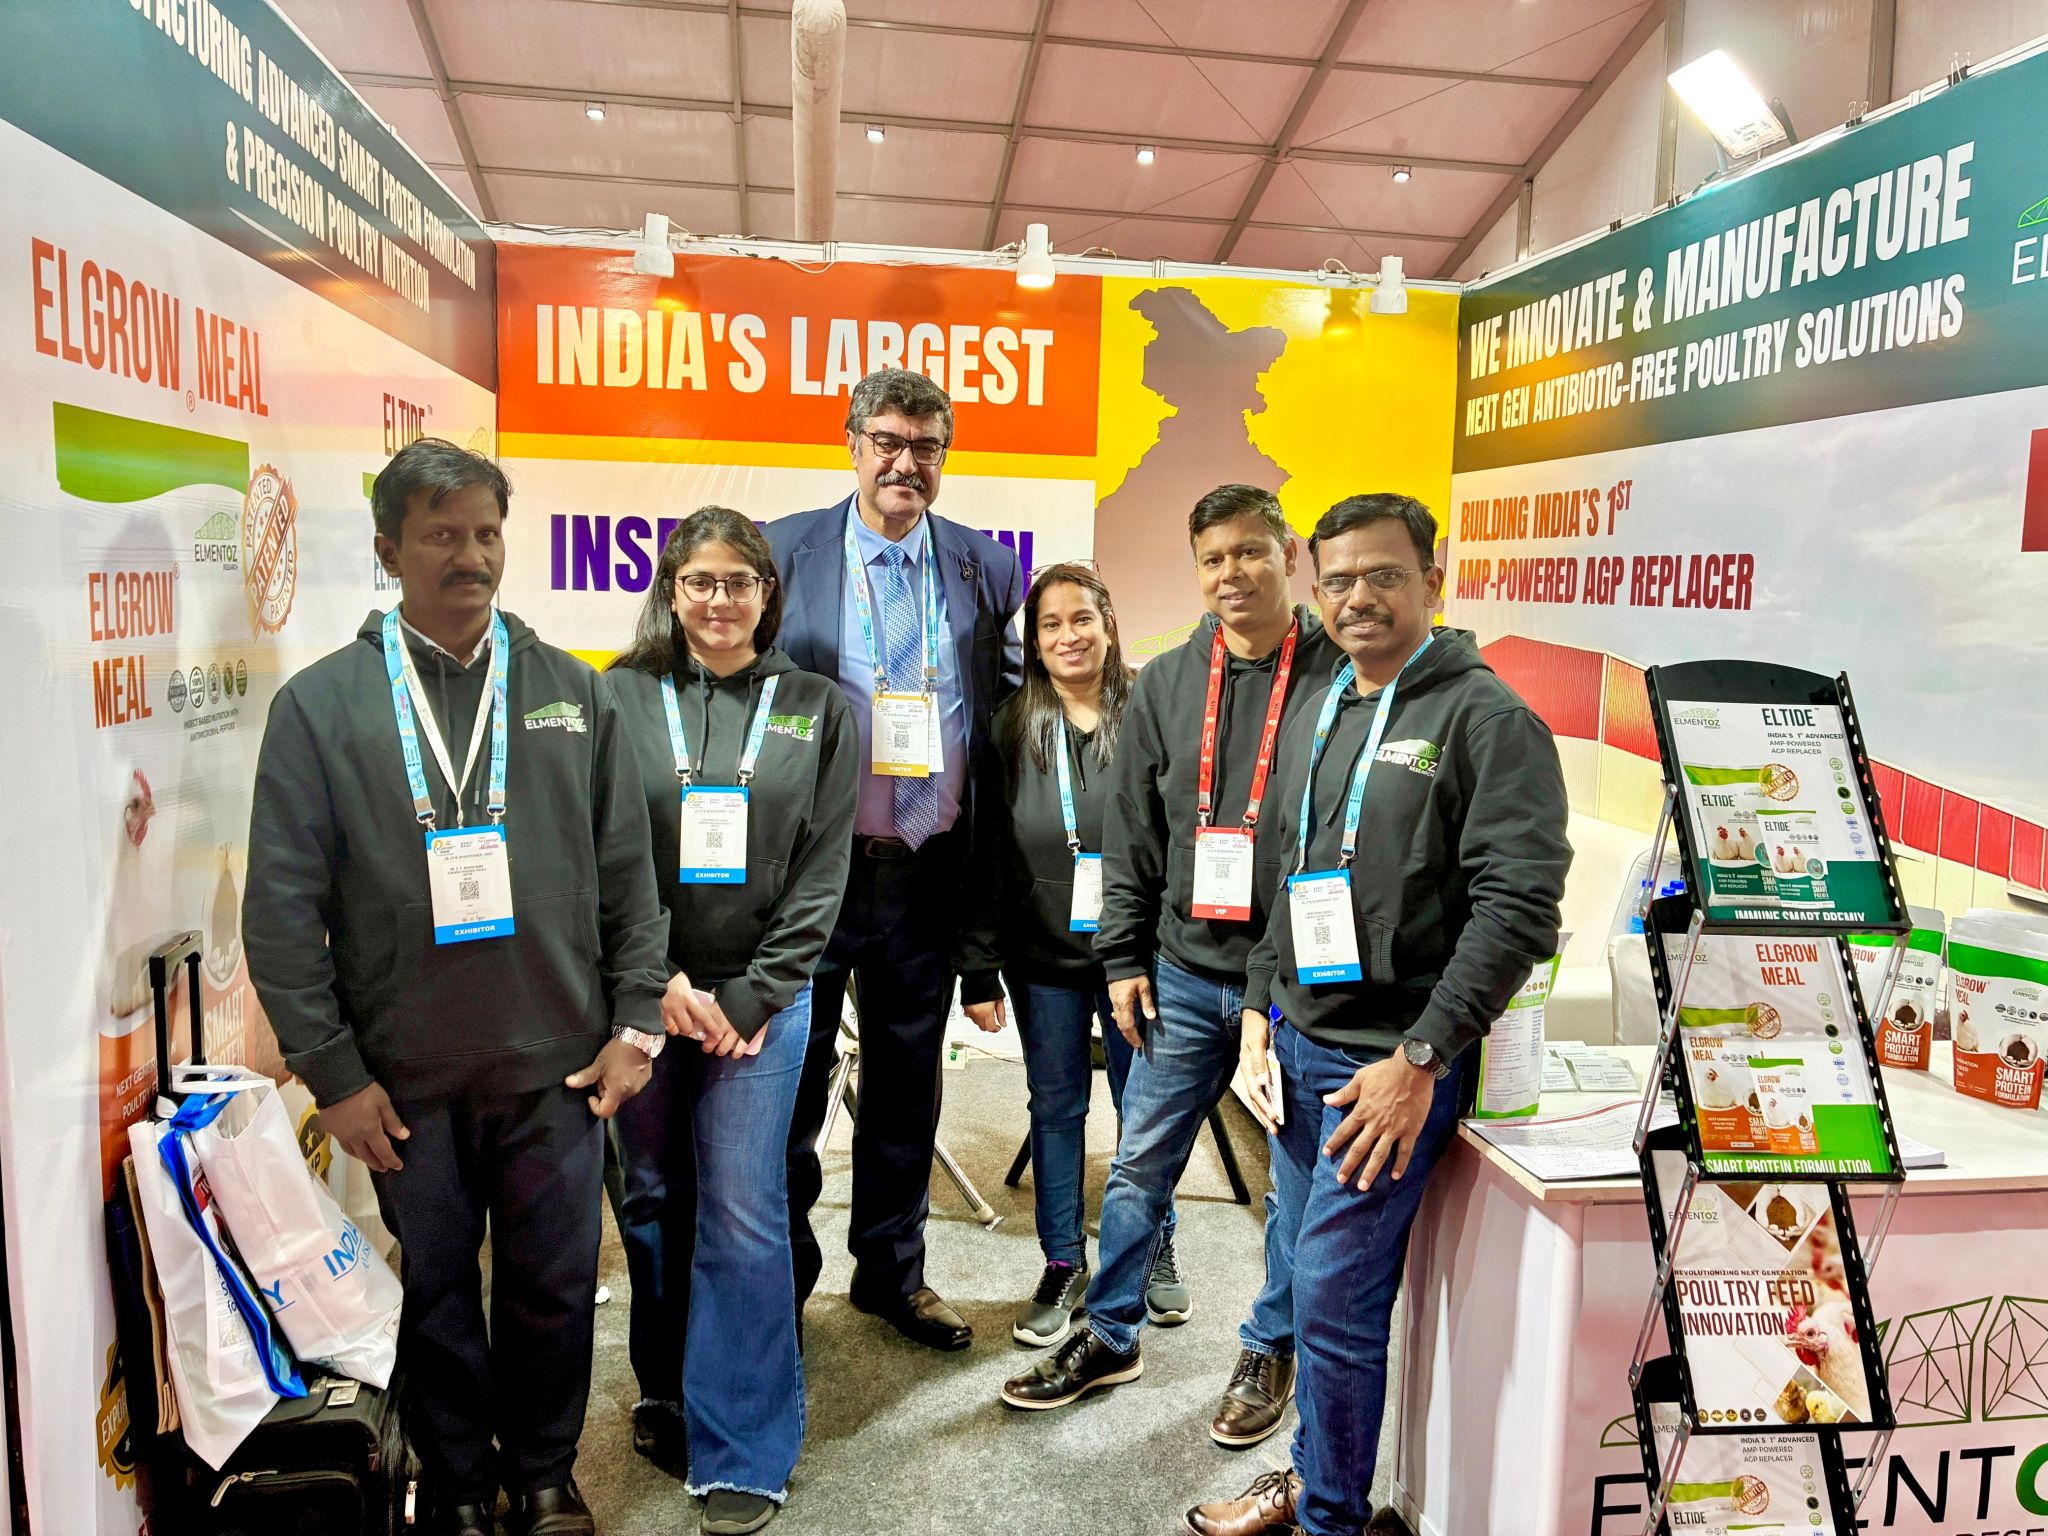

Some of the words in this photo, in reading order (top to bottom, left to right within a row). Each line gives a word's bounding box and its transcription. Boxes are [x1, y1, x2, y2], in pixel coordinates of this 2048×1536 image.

[258, 50, 336, 172] ADVANCED
[338, 126, 380, 211] SMART
[382, 166, 422, 247] PROTEIN
[423, 205, 476, 292] FORMULATION
[225, 121, 240, 185] &
[243, 125, 325, 242] PRECISION
[327, 191, 380, 279] POULTRY
[381, 234, 430, 314] NUTRITION
[1470, 321, 1502, 380] WE
[1507, 268, 1627, 366] INNOVATE
[1633, 266, 1654, 335] &
[1663, 141, 1976, 326] MANUFACTURE
[31, 237, 181, 392] ELGROW
[196, 307, 269, 417] MEAL
[536, 304, 767, 394] INDIA'S
[790, 316, 1053, 406] LARGEST
[1466, 398, 1498, 437] NEXT
[1501, 387, 1530, 430] GEN
[1532, 361, 1678, 424] ANTIBIOTIC-FREE
[1683, 317, 1791, 395] POULTRY
[1795, 272, 1967, 370] SOLUTIONS
[1460, 495, 1529, 543] BUILDING
[1607, 479, 1633, 536] 1ST
[194, 543, 238, 563] ELMENTOZ
[250, 494, 290, 606] PATENTED
[1456, 557, 1578, 604] AMP-POWERED
[1583, 556, 1624, 606] AGP
[1629, 553, 1755, 611] REPLACER
[89, 570, 174, 642] ELGROW
[93, 655, 152, 730] MEAL
[524, 716, 585, 730] ELMENTOZ
[1674, 717, 1720, 726] ELMENTOZ
[1761, 707, 1816, 727] ELTIDE
[1701, 794, 1735, 807] ELTIDE
[1764, 821, 1791, 832] ELTIDE
[454, 925, 496, 936] EXHIBITOR
[1755, 943, 1819, 963] ELGROW
[1312, 969, 1346, 978] EXHIBITOR
[1761, 967, 1806, 986] MEAL
[1955, 974, 1987, 994] ELGROW
[204, 984, 246, 1058] SMART
[1689, 1036, 1723, 1049] ELGROW
[1884, 1030, 1922, 1046] SMART
[1692, 1050, 1716, 1062] MEAL
[1884, 1042, 1920, 1055] PROTEIN
[1884, 1053, 1919, 1063] FORMULATION
[1757, 1075, 1781, 1084] ELGROW
[1995, 1066, 2035, 1084] SMART
[116, 1078, 133, 1099] NEXT
[1759, 1084, 1775, 1093] MEAL
[1994, 1079, 2032, 1095] PROTEIN
[1994, 1090, 2031, 1102] FORMULATION
[122, 1086, 152, 1119] POULTRY
[1676, 1280, 1760, 1307] POULTRY
[1766, 1280, 1816, 1306] FEED
[1681, 1312, 1787, 1336] INNOVATION
[1742, 1446, 1794, 1454] AMP-POWERED
[1674, 1511, 1708, 1525] ELTIDE
